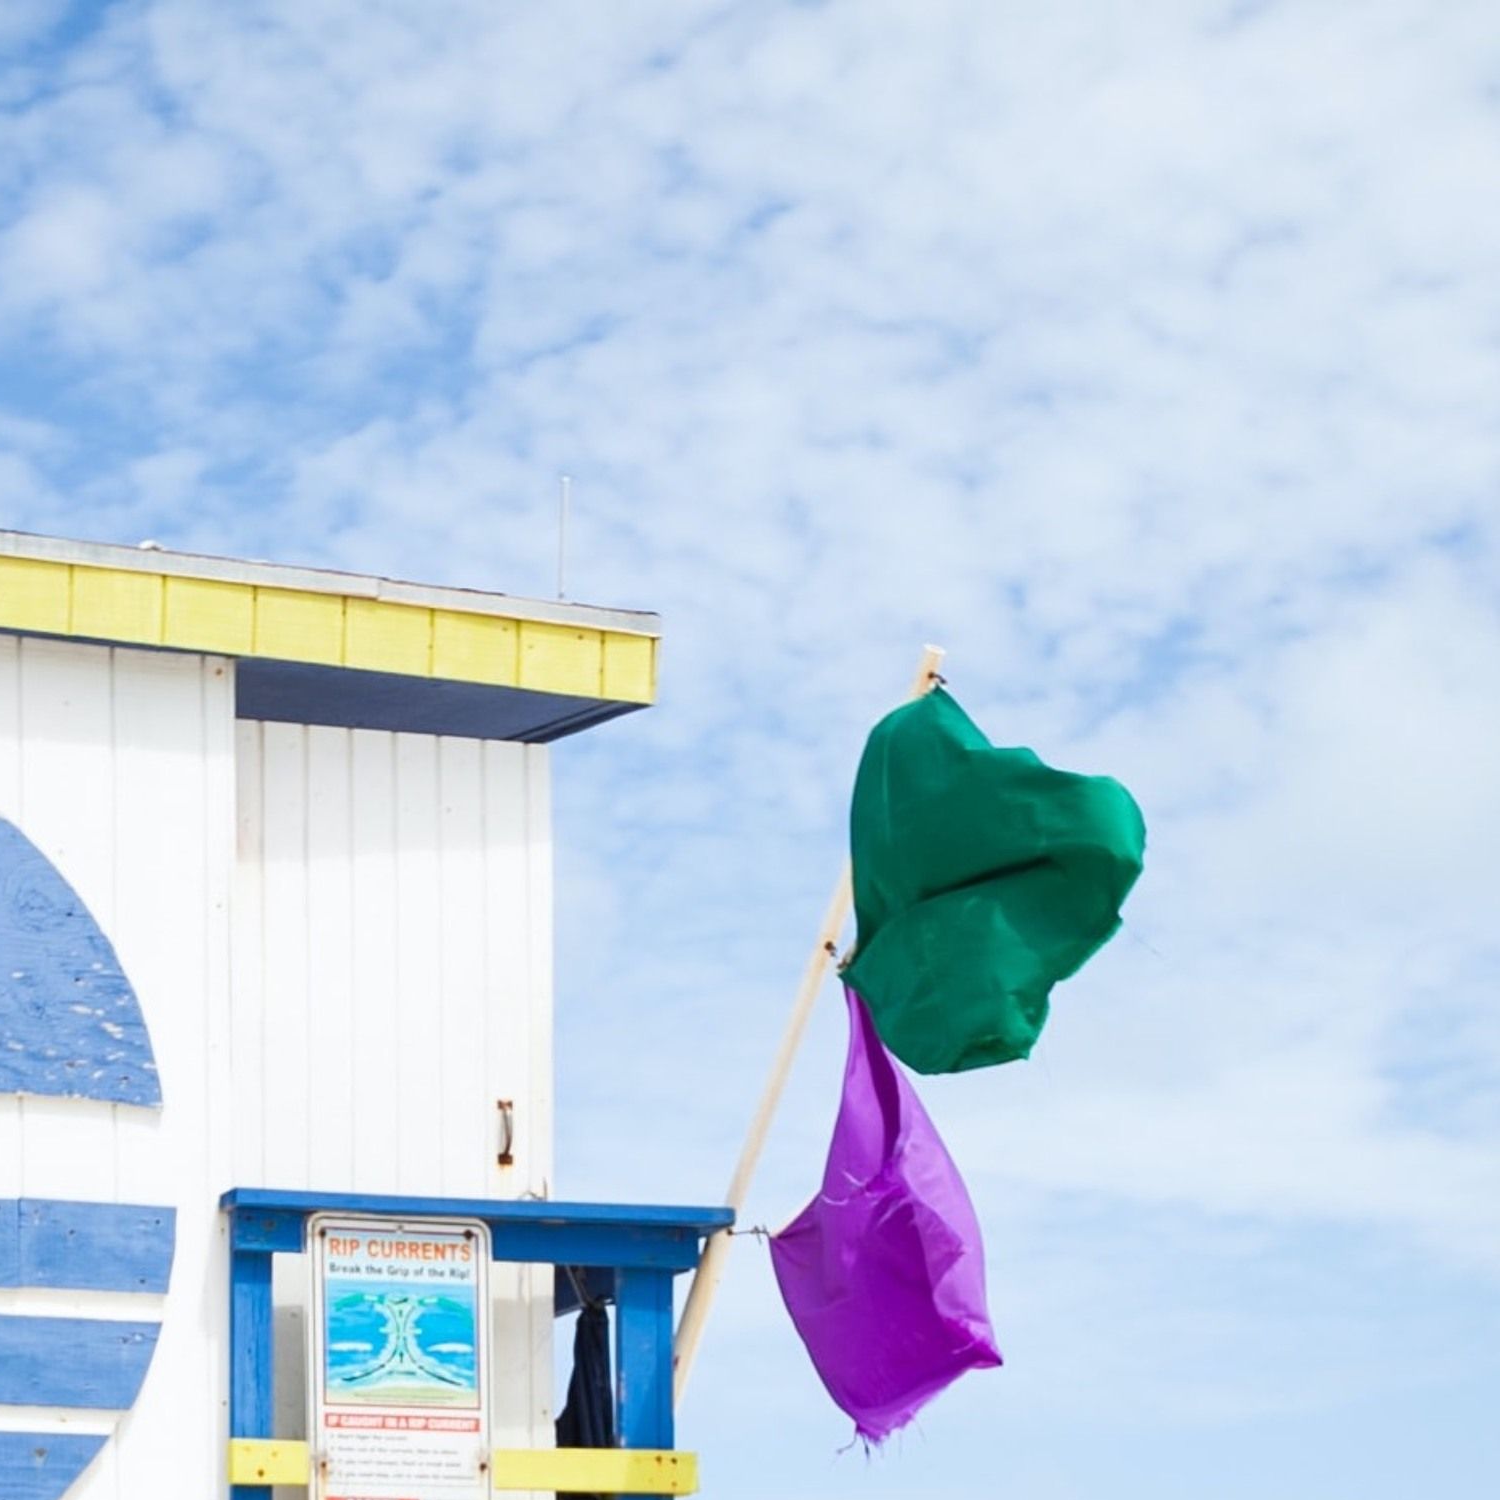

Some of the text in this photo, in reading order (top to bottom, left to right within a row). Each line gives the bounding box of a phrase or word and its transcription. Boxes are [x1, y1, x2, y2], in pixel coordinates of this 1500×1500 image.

[329, 1238, 471, 1262] RIP CURRENTS
[329, 1262, 361, 1273] Break
[365, 1264, 383, 1275] the
[413, 1267, 423, 1276] of
[427, 1268, 445, 1278] the
